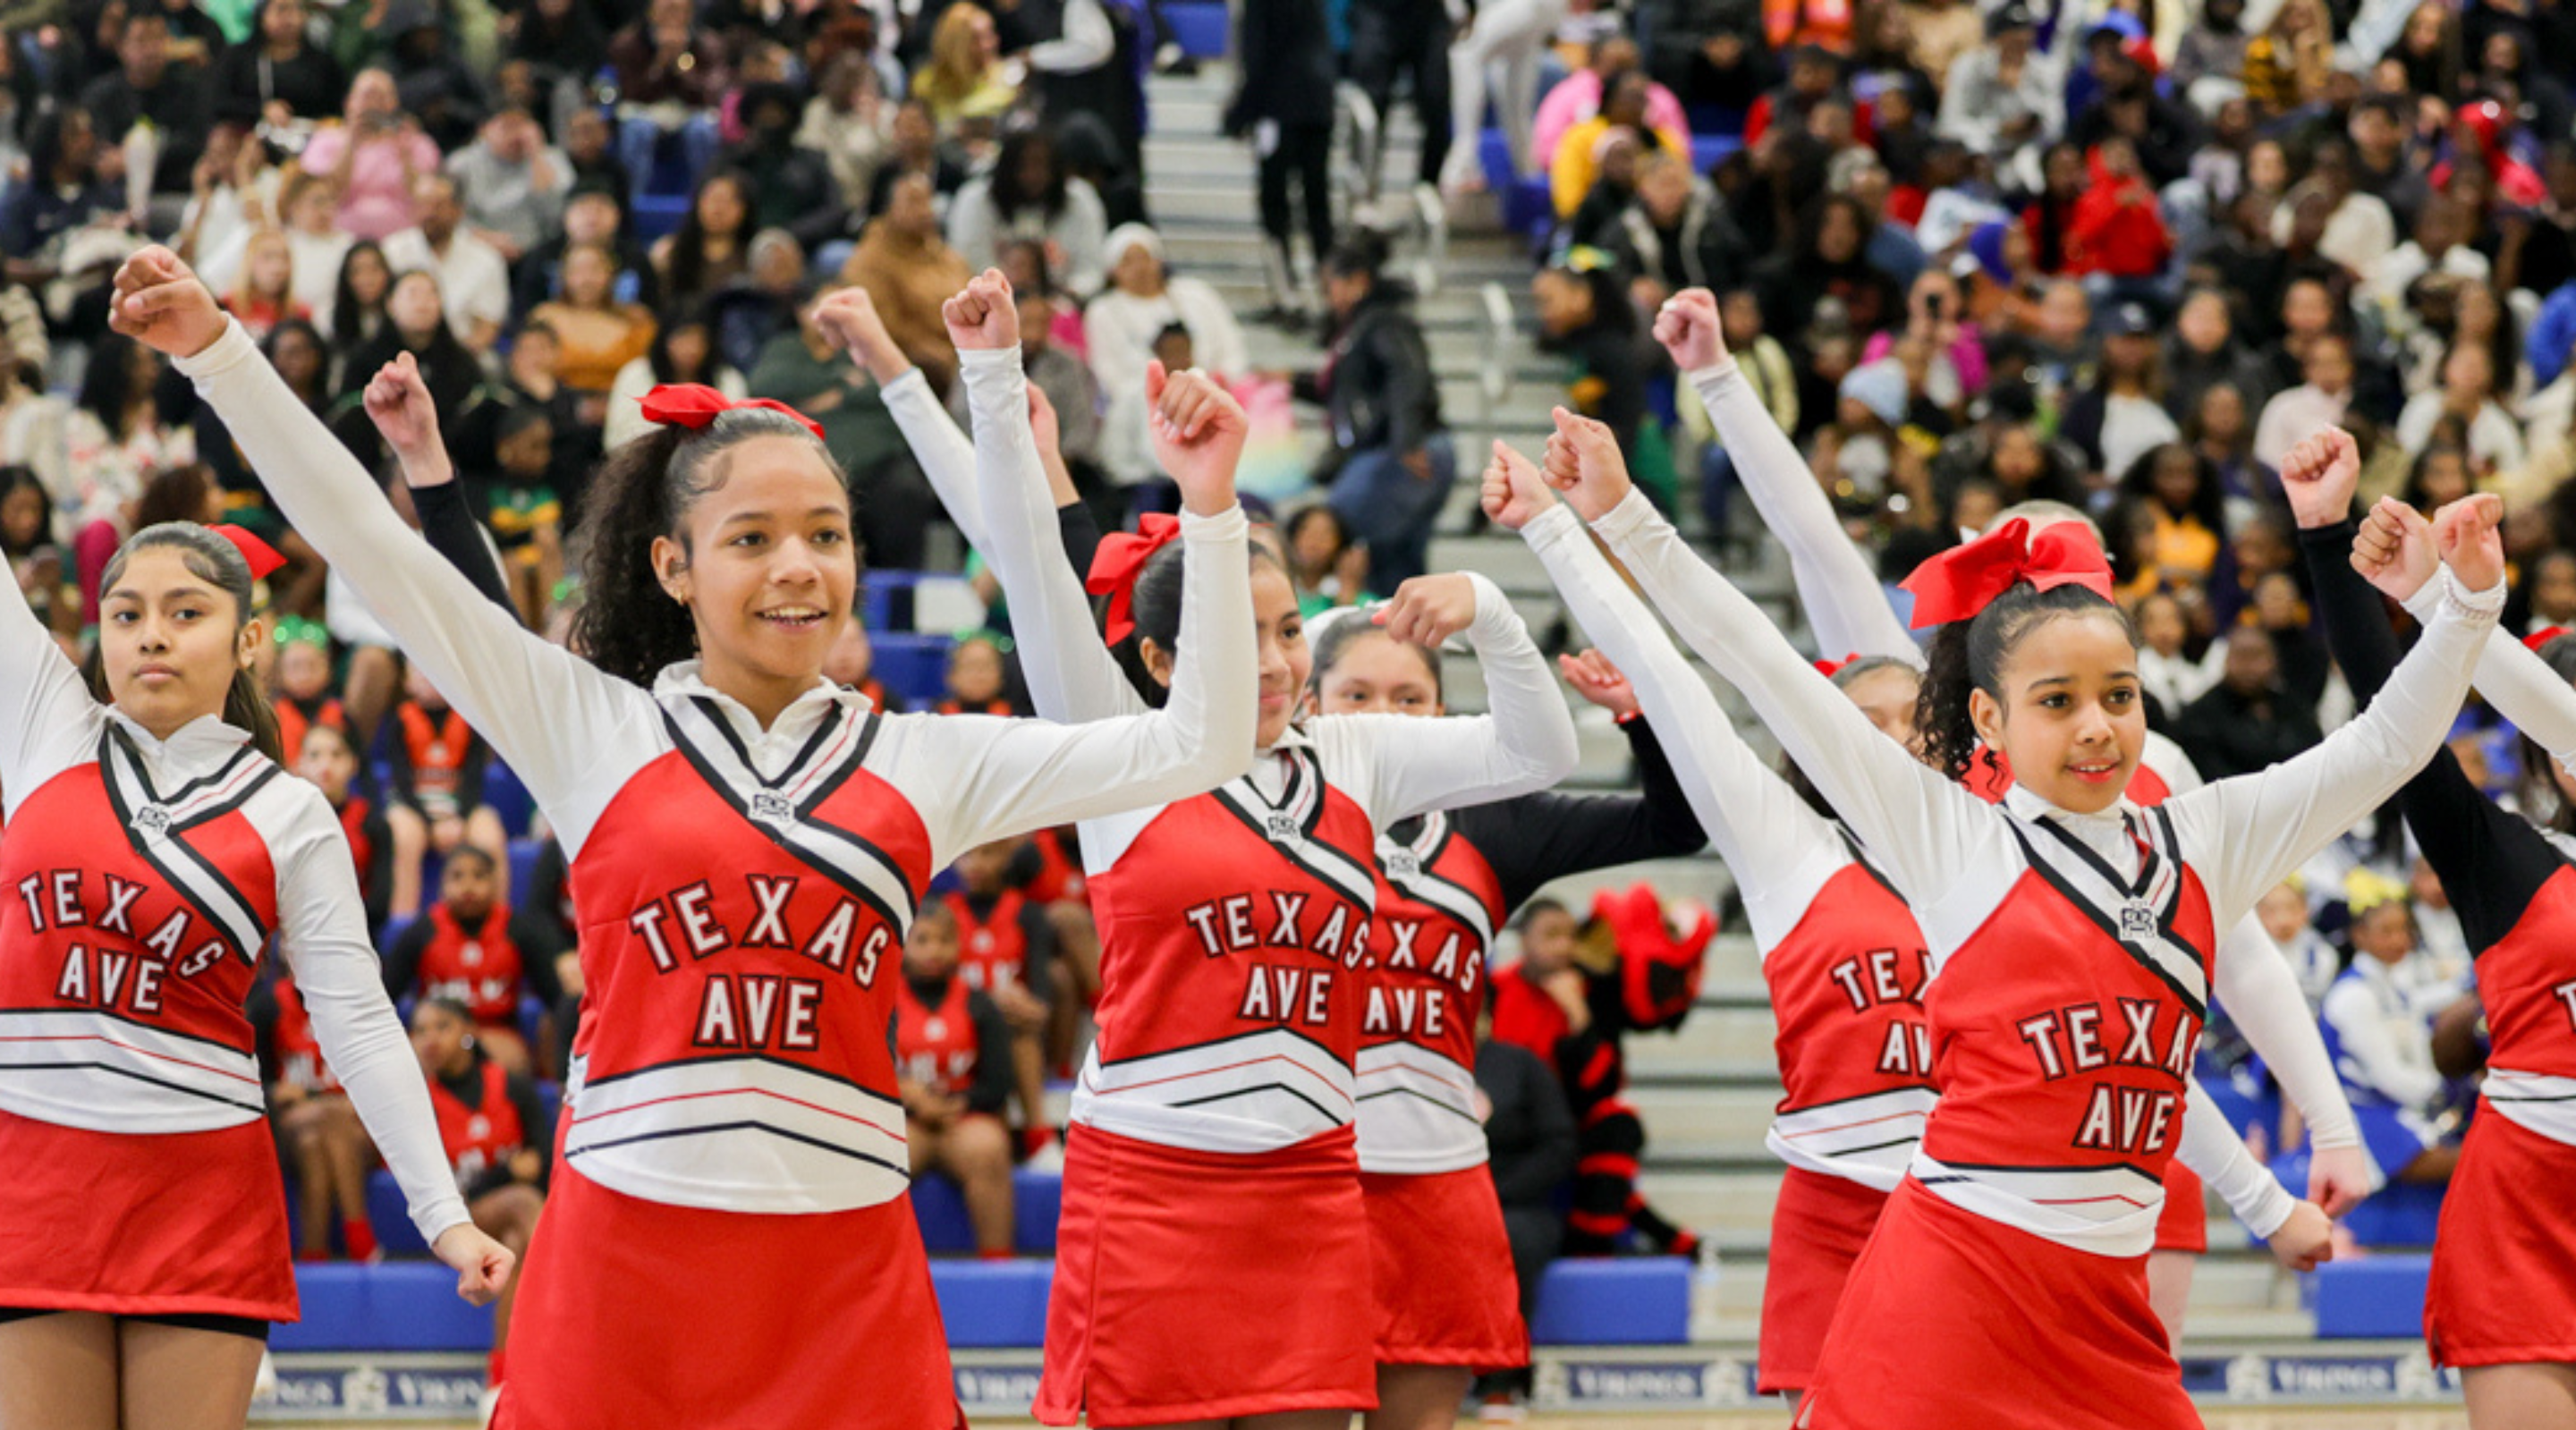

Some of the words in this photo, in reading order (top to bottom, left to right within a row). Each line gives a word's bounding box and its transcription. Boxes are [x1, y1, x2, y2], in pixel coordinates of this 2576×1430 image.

[18, 870, 226, 979] TEXAS
[629, 874, 891, 990] TEXAS
[1185, 891, 1371, 970] TEXAS
[1363, 918, 1485, 994] XAS
[54, 943, 166, 1015] AVE
[691, 974, 824, 1051] AVE
[1237, 963, 1335, 1027] AVE
[1361, 985, 1447, 1038] AVE
[1828, 948, 1937, 1014] TEX
[1875, 1019, 1933, 1079] AV
[2072, 1082, 2177, 1155] AVE
